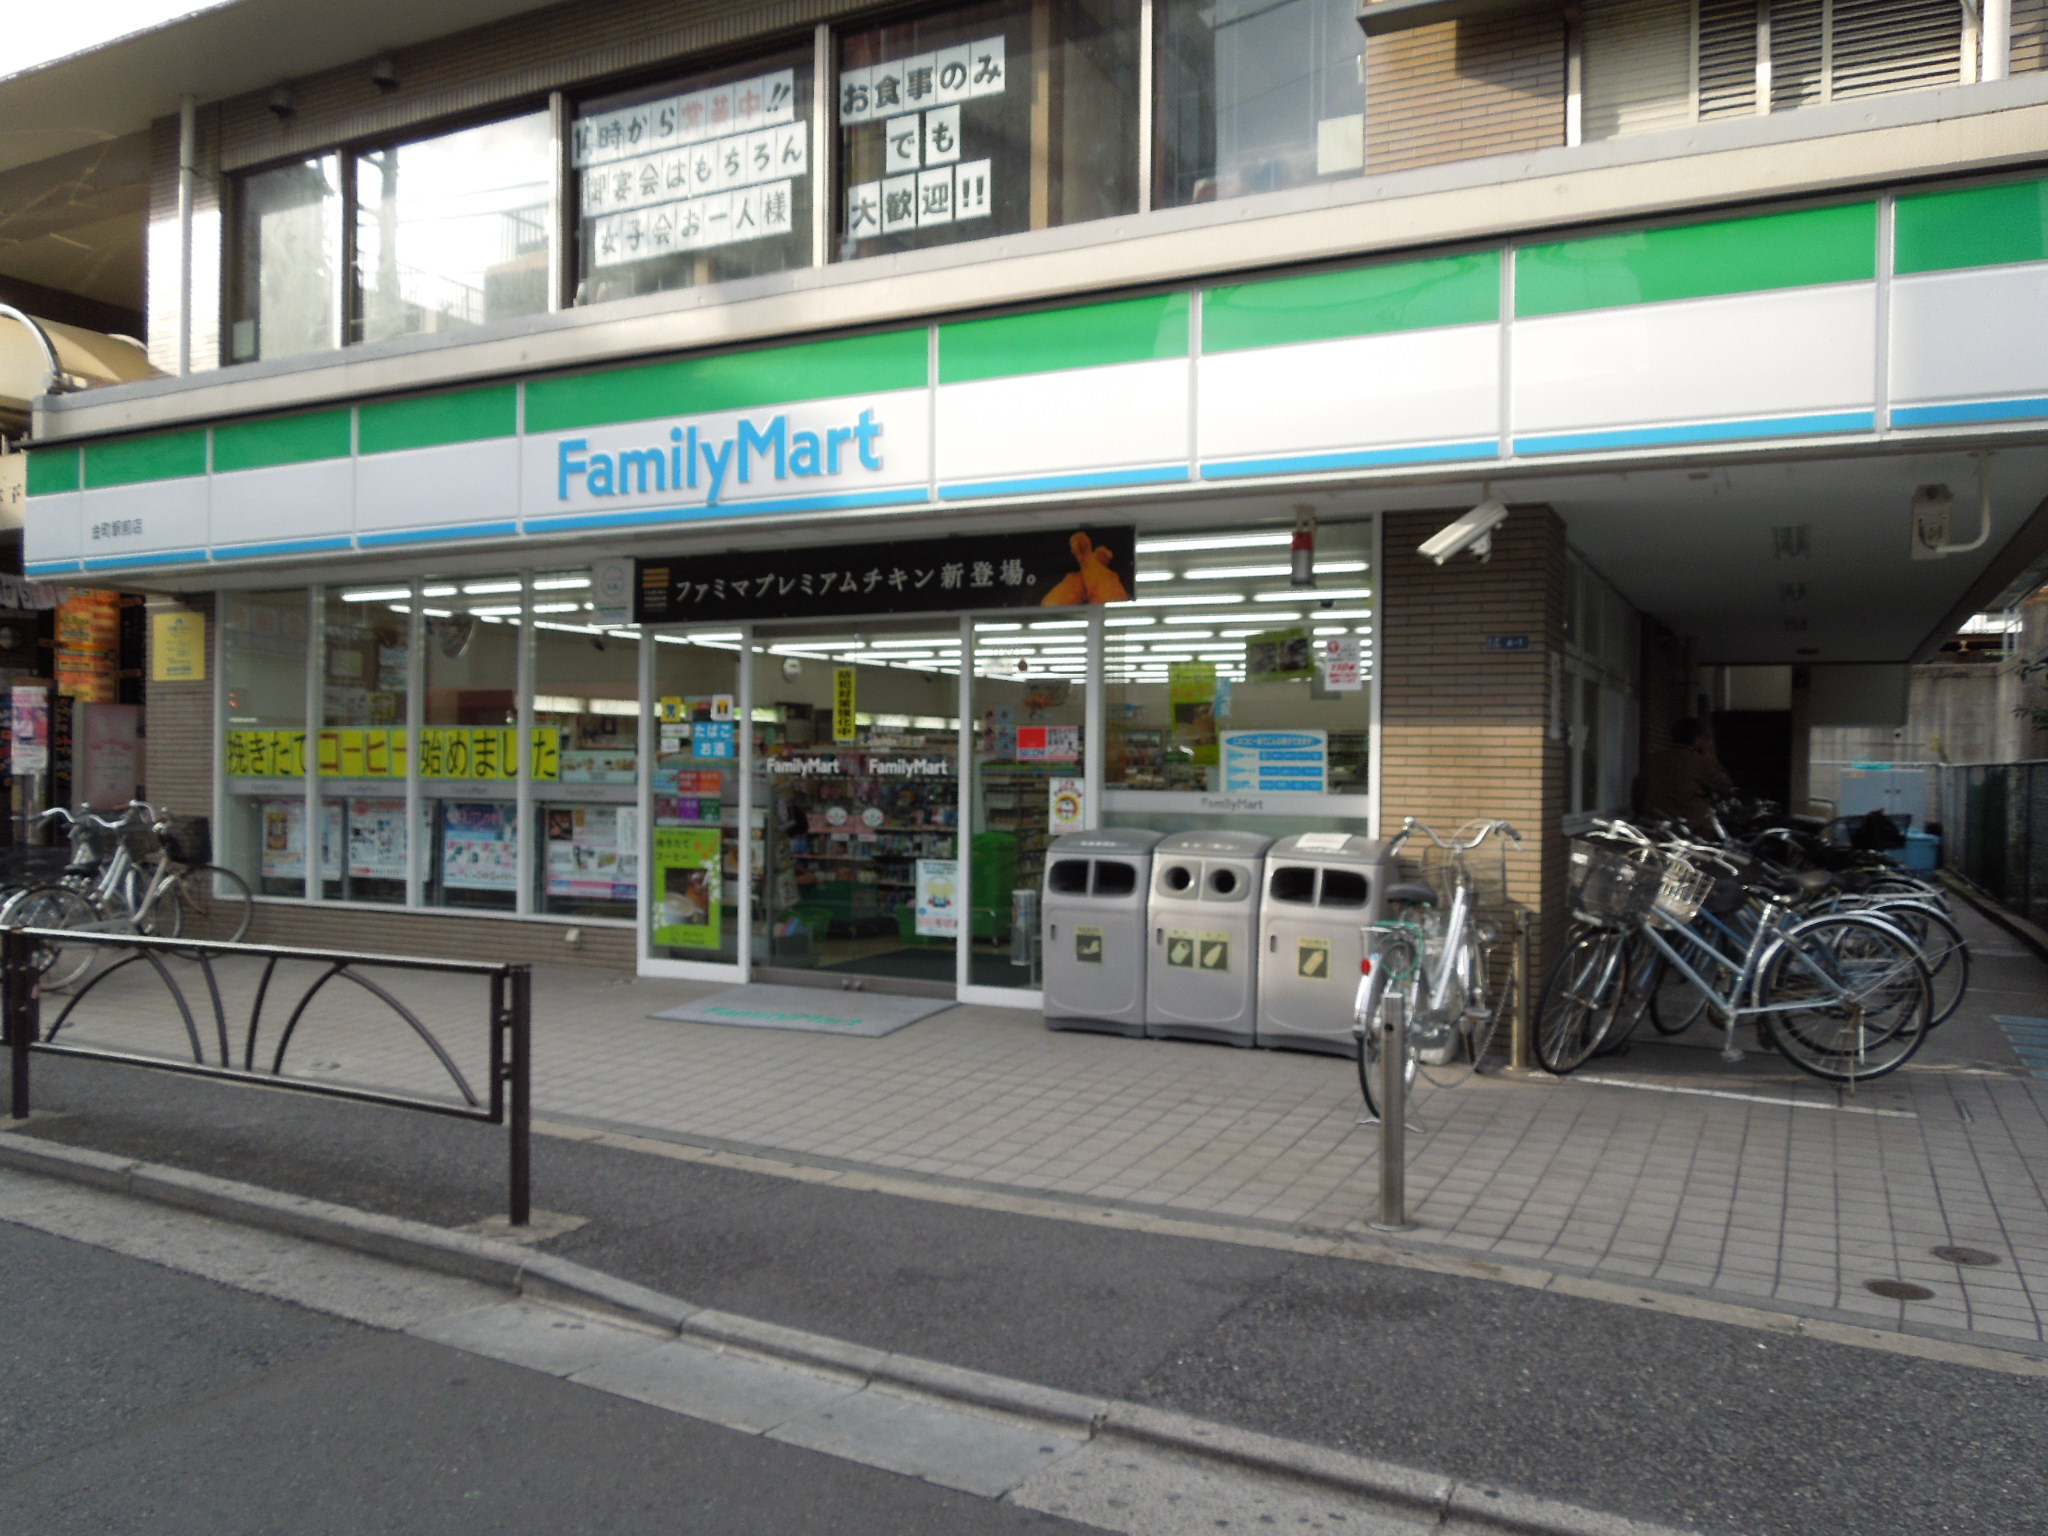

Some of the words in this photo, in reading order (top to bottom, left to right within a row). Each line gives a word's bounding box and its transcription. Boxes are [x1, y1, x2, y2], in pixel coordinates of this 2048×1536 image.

[842, 54, 1002, 114] お食事のみ
[889, 121, 954, 159] でも
[585, 135, 803, 208] 御宴会はもちろん
[601, 190, 787, 254] 女子会お一人様
[851, 176, 984, 229] 大歓迎!!
[557, 406, 883, 506] FamilyMart
[675, 558, 1037, 602] ファミマプレミアムチキン新登場。
[694, 723, 732, 738] たばこ
[766, 757, 841, 778] FamilyMart
[868, 757, 949, 779] FamilyMart
